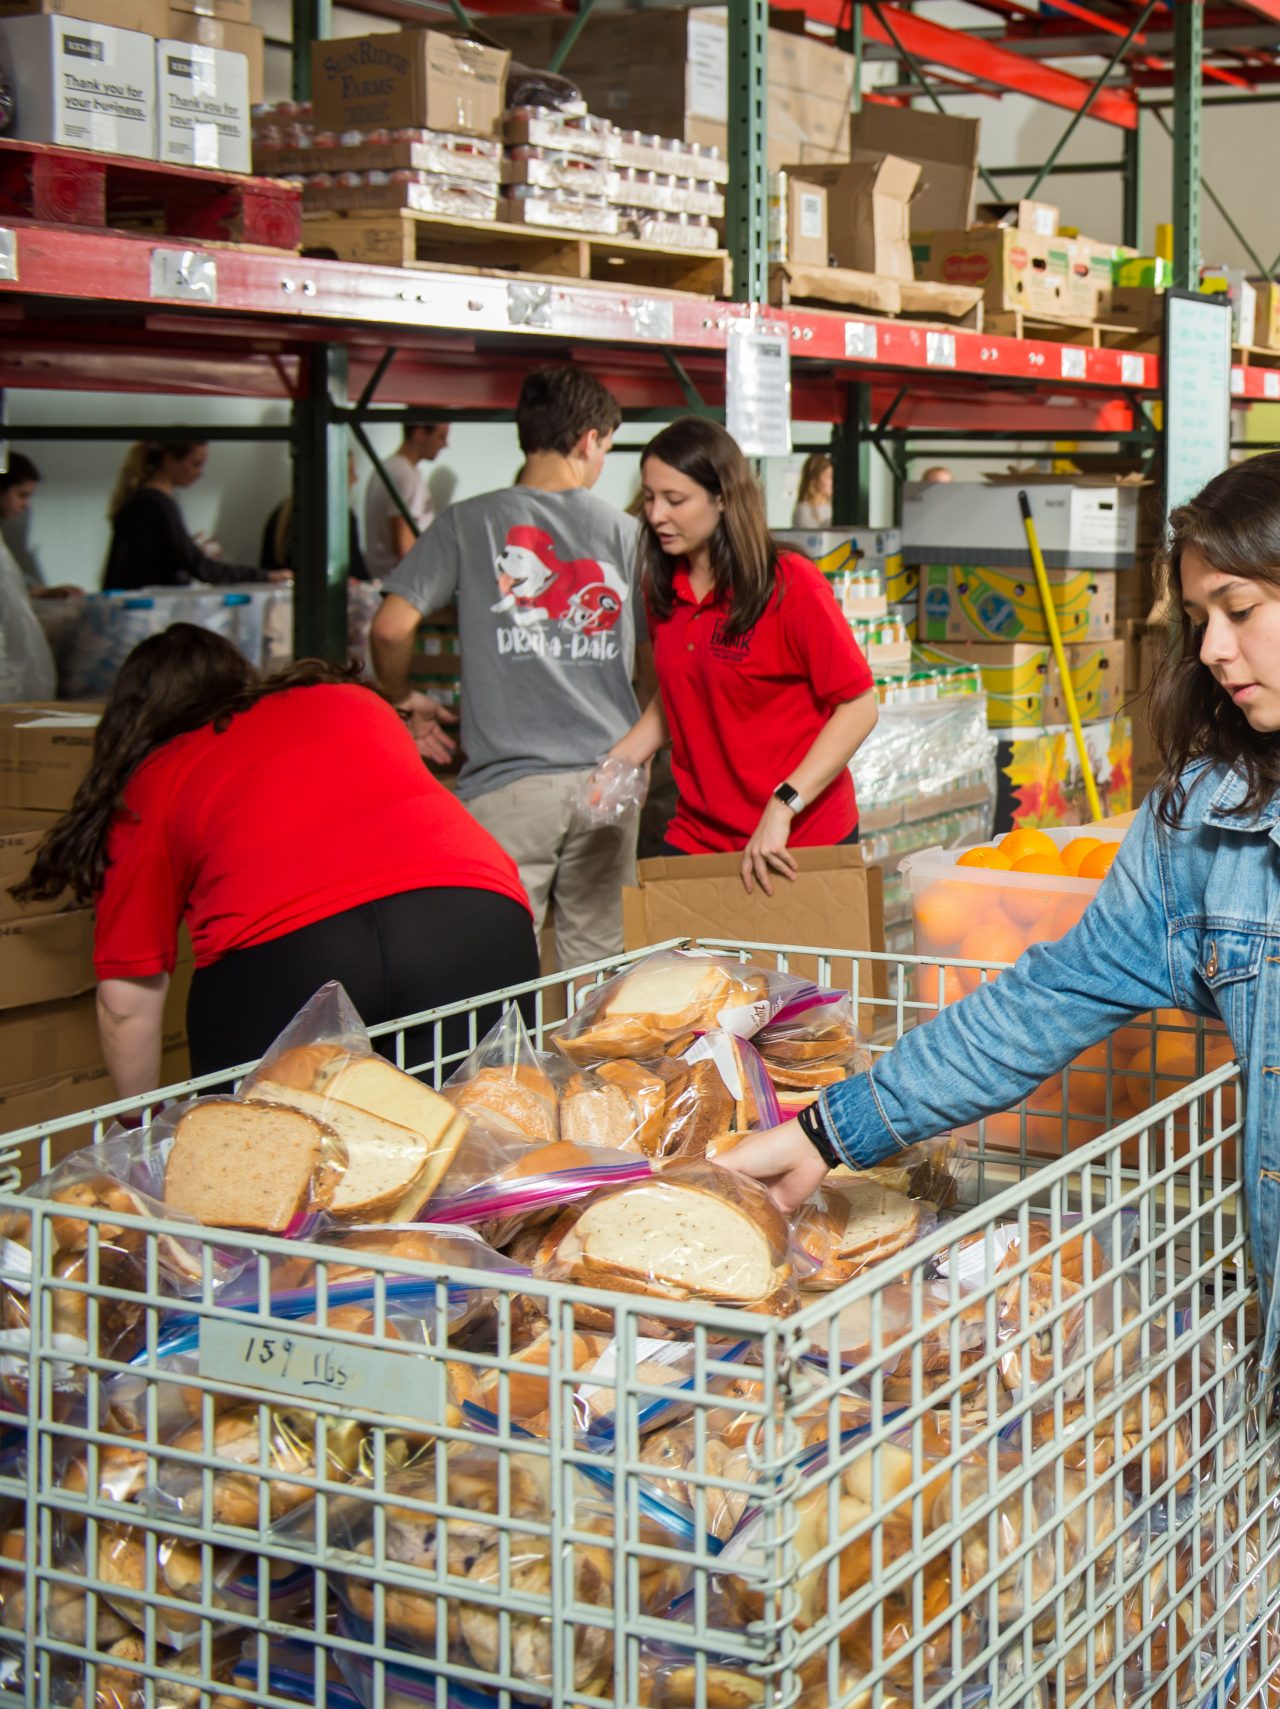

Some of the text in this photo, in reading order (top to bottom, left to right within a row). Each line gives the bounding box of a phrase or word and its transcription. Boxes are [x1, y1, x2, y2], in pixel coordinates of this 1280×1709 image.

[63, 73, 144, 98] Thank you for
[65, 96, 92, 110] your
[168, 93, 239, 116] Thank you for
[245, 1337, 295, 1378] 159
